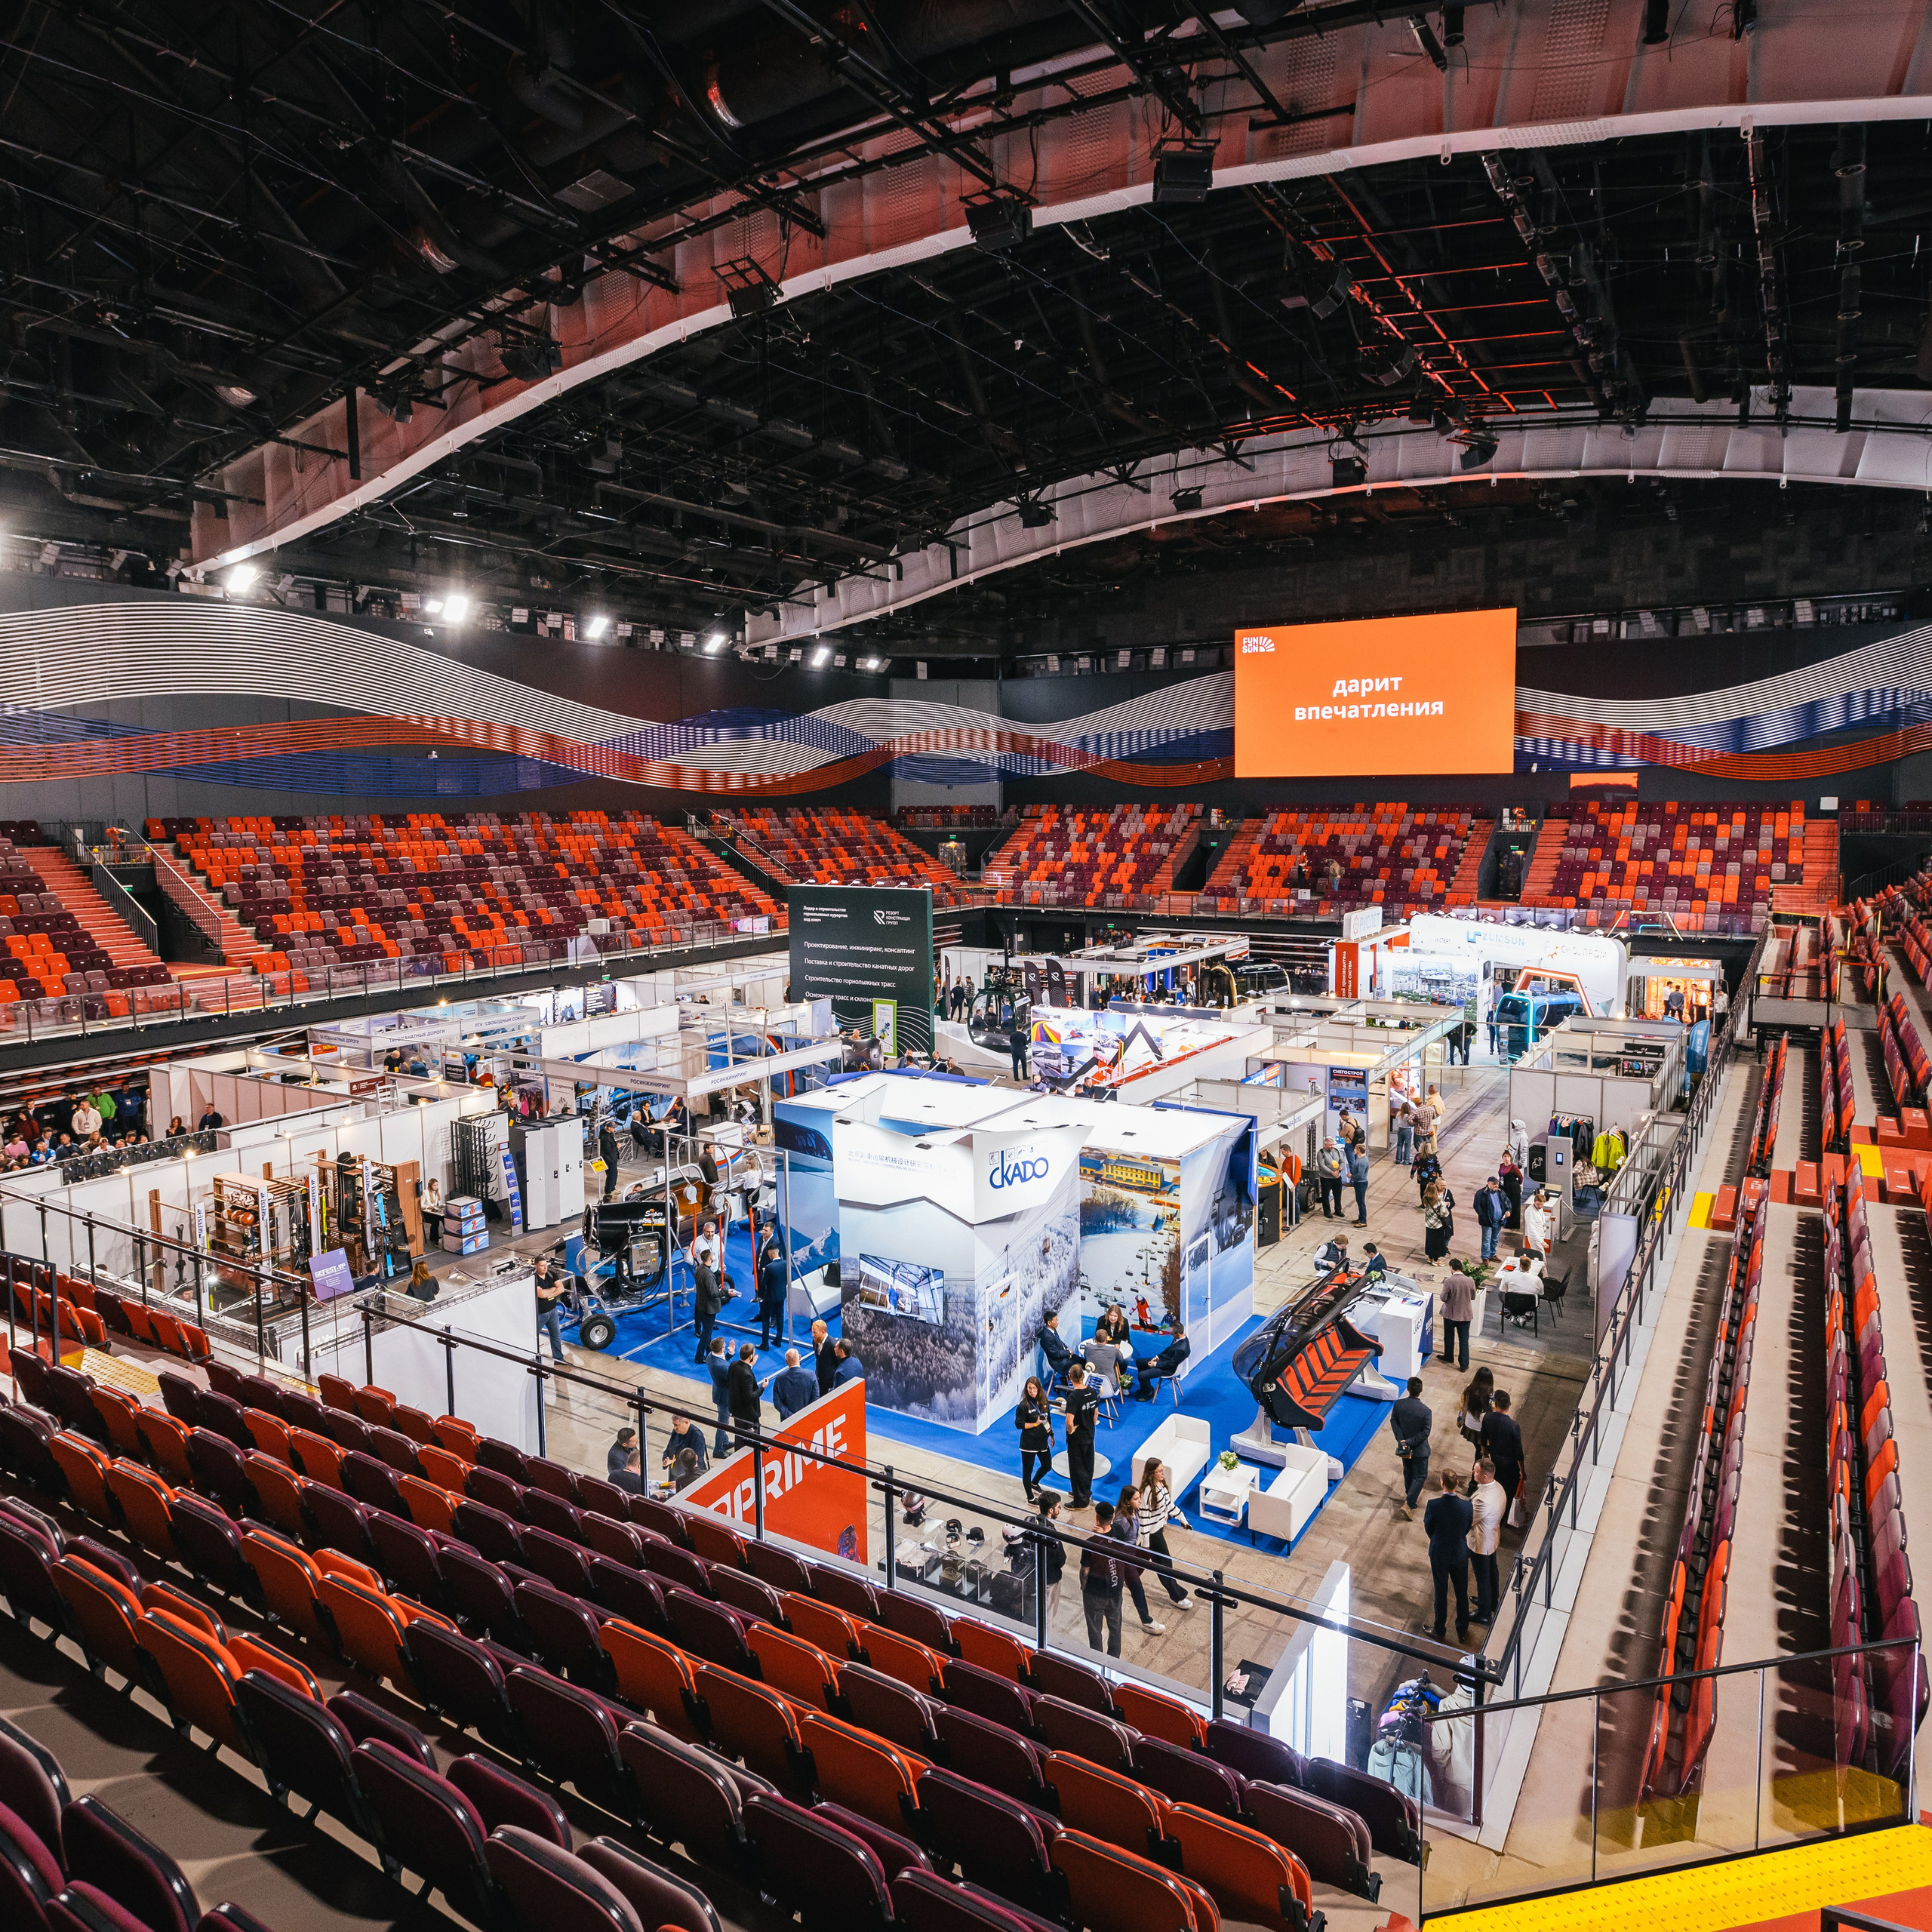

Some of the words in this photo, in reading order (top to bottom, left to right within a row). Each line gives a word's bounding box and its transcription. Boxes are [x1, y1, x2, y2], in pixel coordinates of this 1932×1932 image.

[1243, 636, 1259, 645] FUN
[1242, 645, 1259, 654] SUN
[1332, 676, 1403, 697] дарит
[1294, 700, 1444, 721] впечатления
[1359, 912, 1380, 932] РУСЛЕТ
[1482, 933, 1524, 946] ZUMSUN
[804, 941, 849, 951] Проектирование,
[804, 958, 828, 966] Поставка
[804, 974, 842, 983] Строительство
[843, 978, 880, 986] горнолыжных
[804, 991, 834, 1000] Оснежение
[483, 1017, 512, 1026] "СВОБОДНЫЙ
[427, 1029, 445, 1037] ДОРОГИ
[711, 1071, 748, 1084] РОСИНЖИНИРИНГ
[1333, 1069, 1364, 1077] СНЕГОСТРОЙ
[630, 1078, 671, 1089] РОСИНЖИНИРИНГ
[469, 1205, 475, 1215] 3
[472, 1220, 476, 1230] 2
[473, 1237, 478, 1248] 1
[314, 1263, 346, 1278] GEFEST-VP
